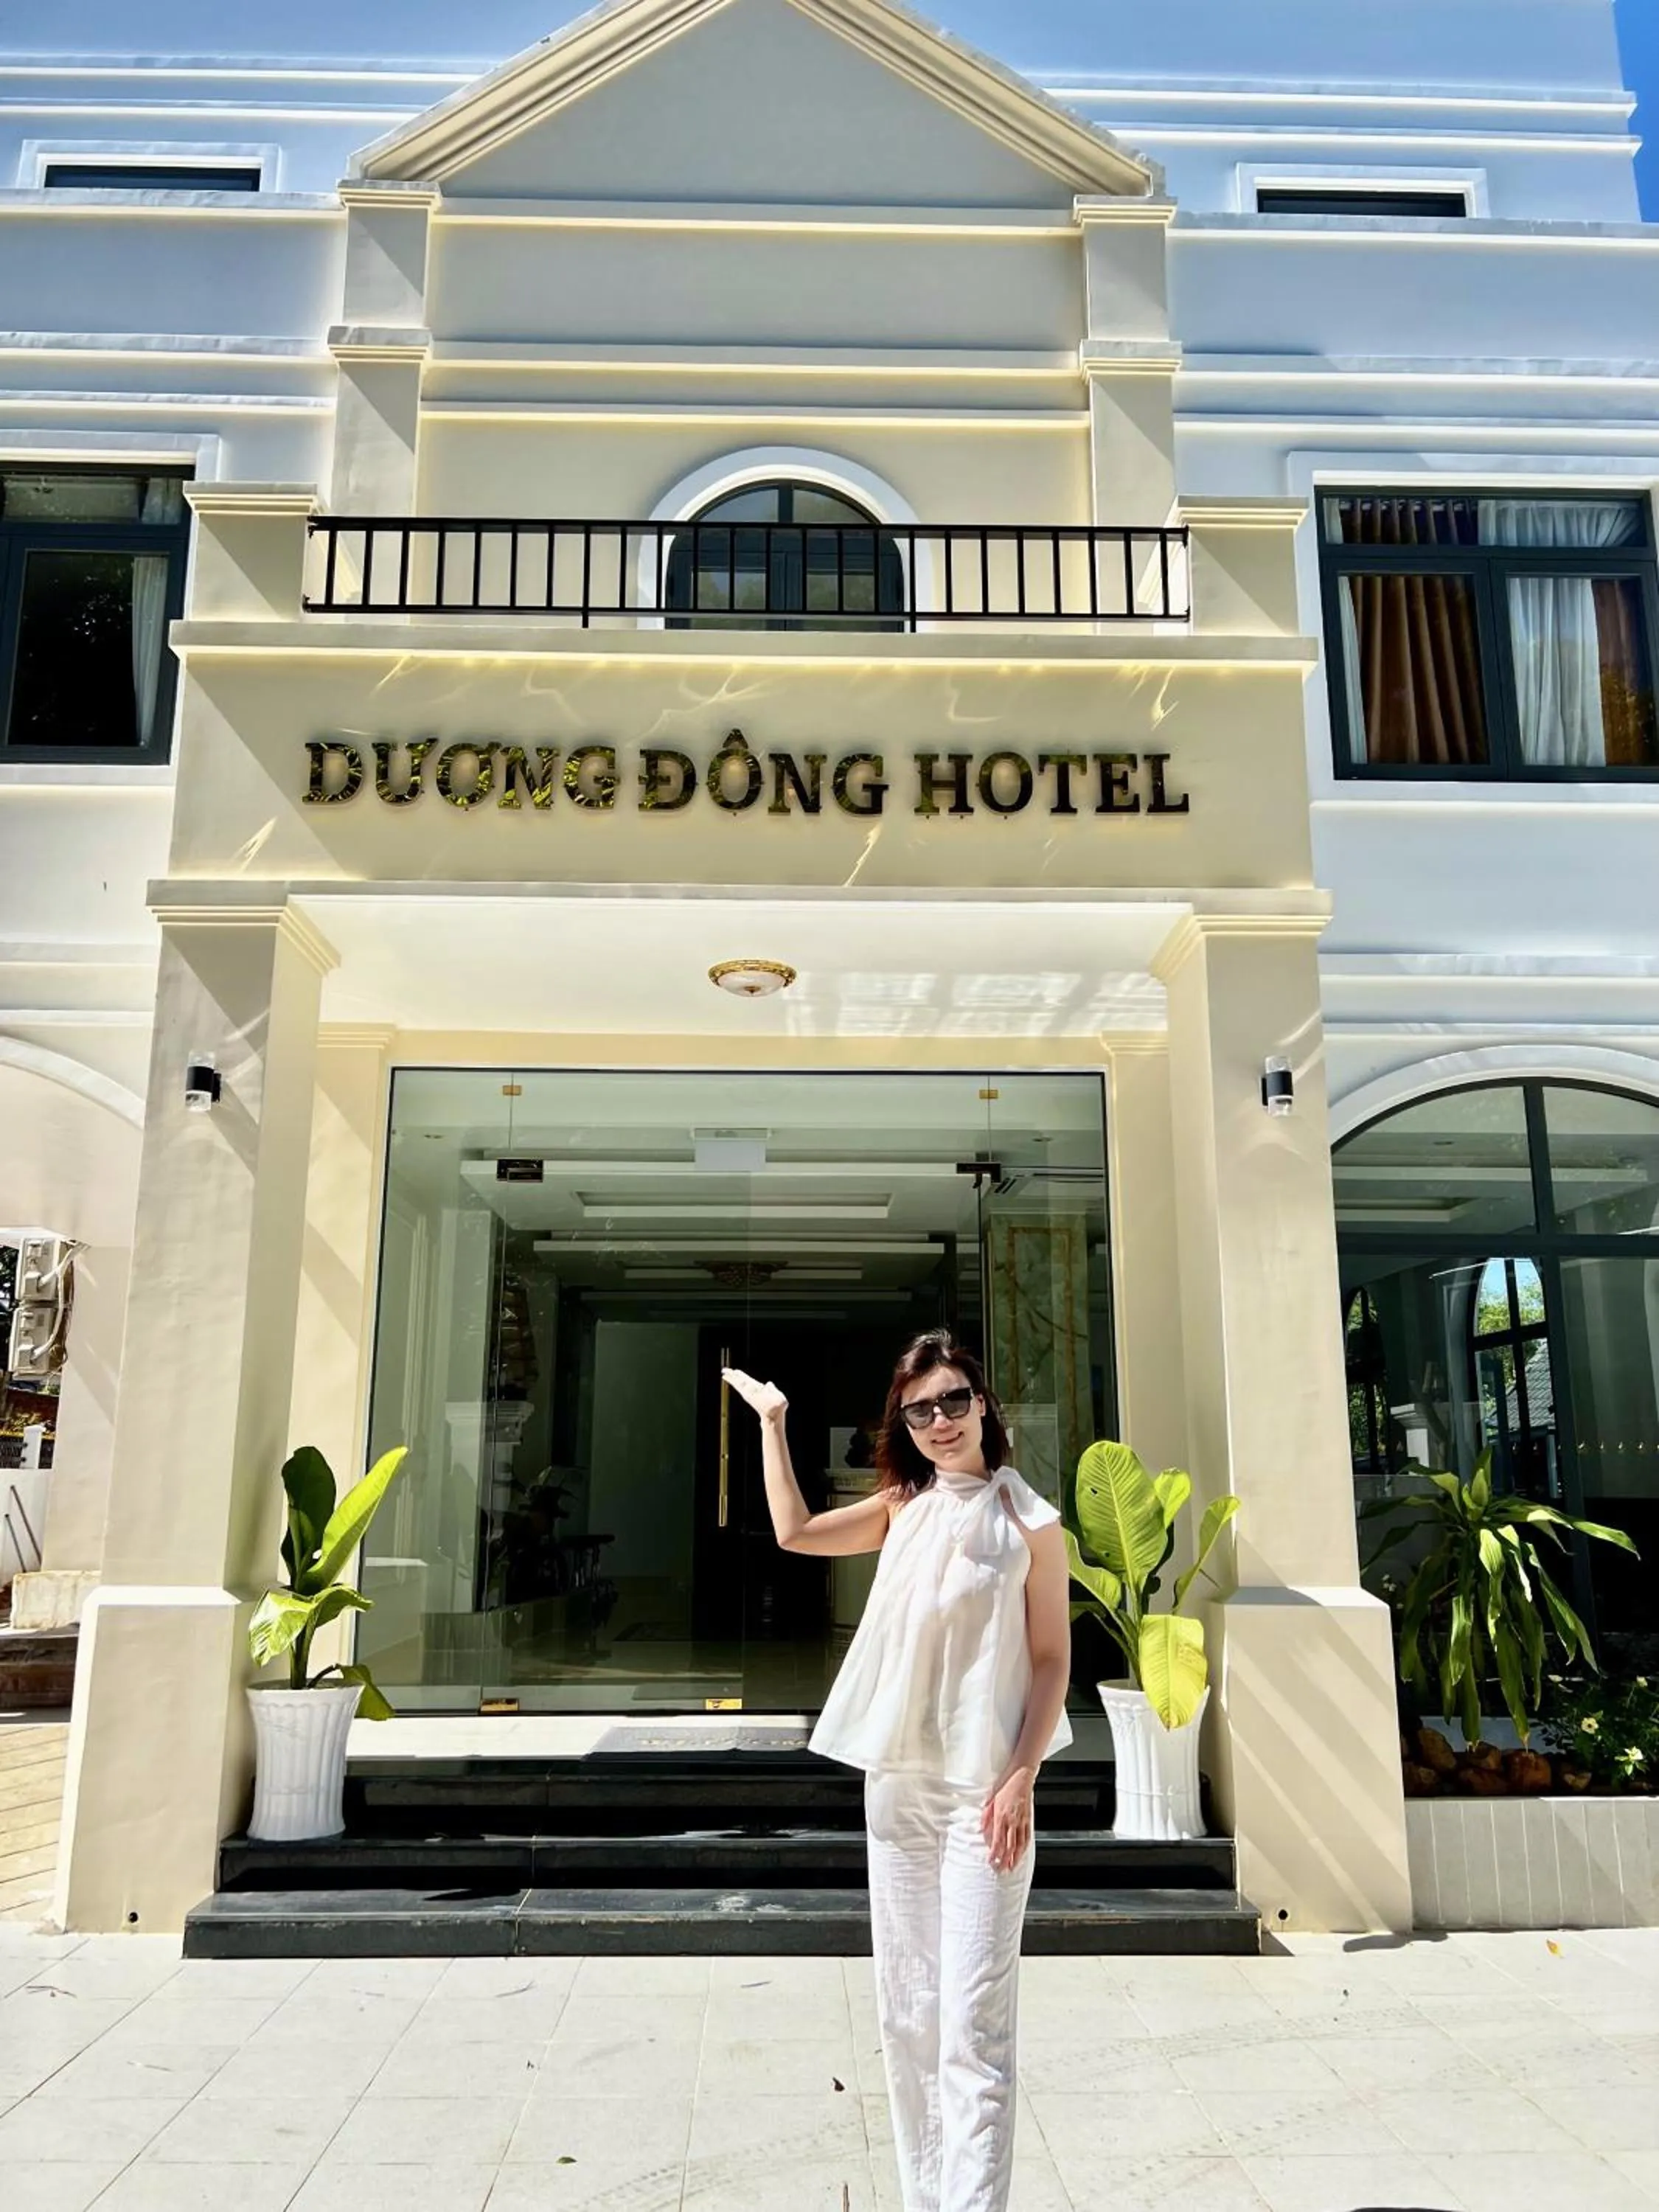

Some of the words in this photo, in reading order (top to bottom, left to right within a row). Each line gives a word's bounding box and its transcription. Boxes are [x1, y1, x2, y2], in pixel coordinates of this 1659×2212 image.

[302, 737, 620, 810] DƯƠNG
[638, 728, 889, 815] ĐÔNG
[914, 751, 1189, 815] HOTEL
